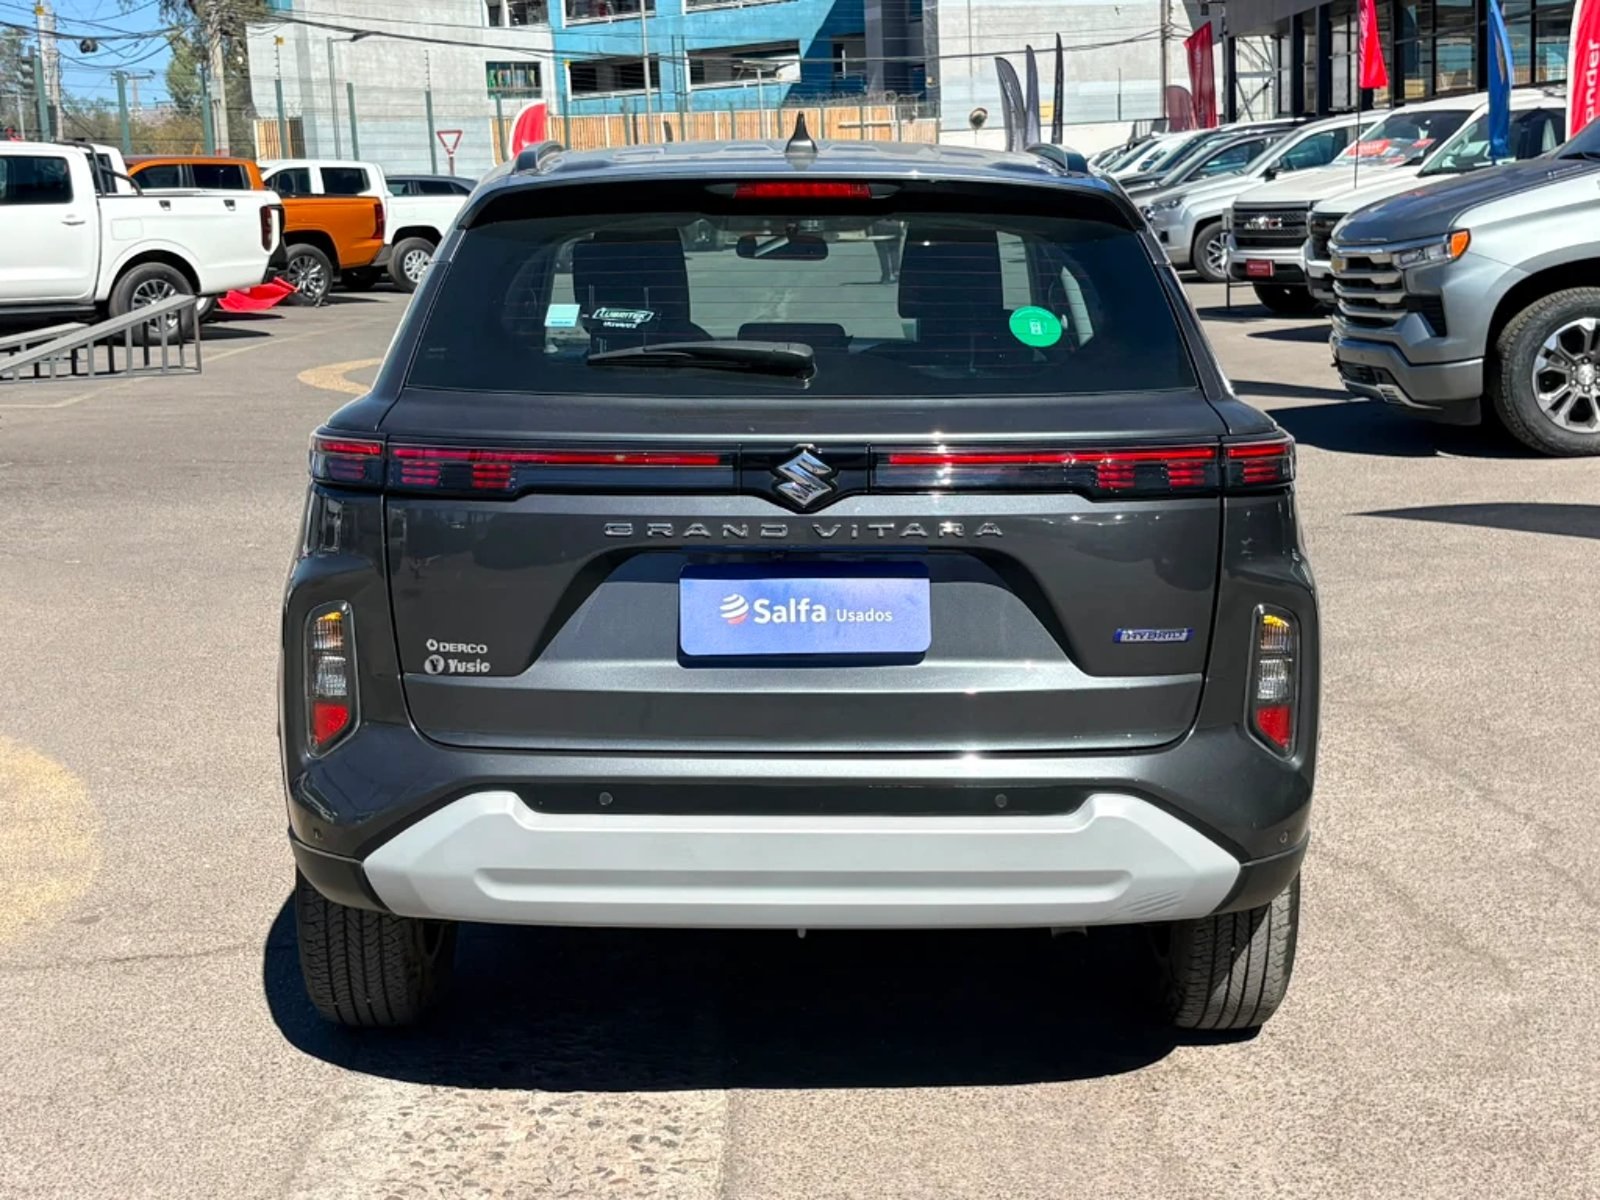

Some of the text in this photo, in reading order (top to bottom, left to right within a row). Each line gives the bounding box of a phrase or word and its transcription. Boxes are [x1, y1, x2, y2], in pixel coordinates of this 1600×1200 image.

[604, 521, 1003, 538] GRAND VITARA
[753, 598, 893, 624] Salfa Usados
[1119, 628, 1187, 642] HYBRID
[439, 642, 488, 654] DERCO
